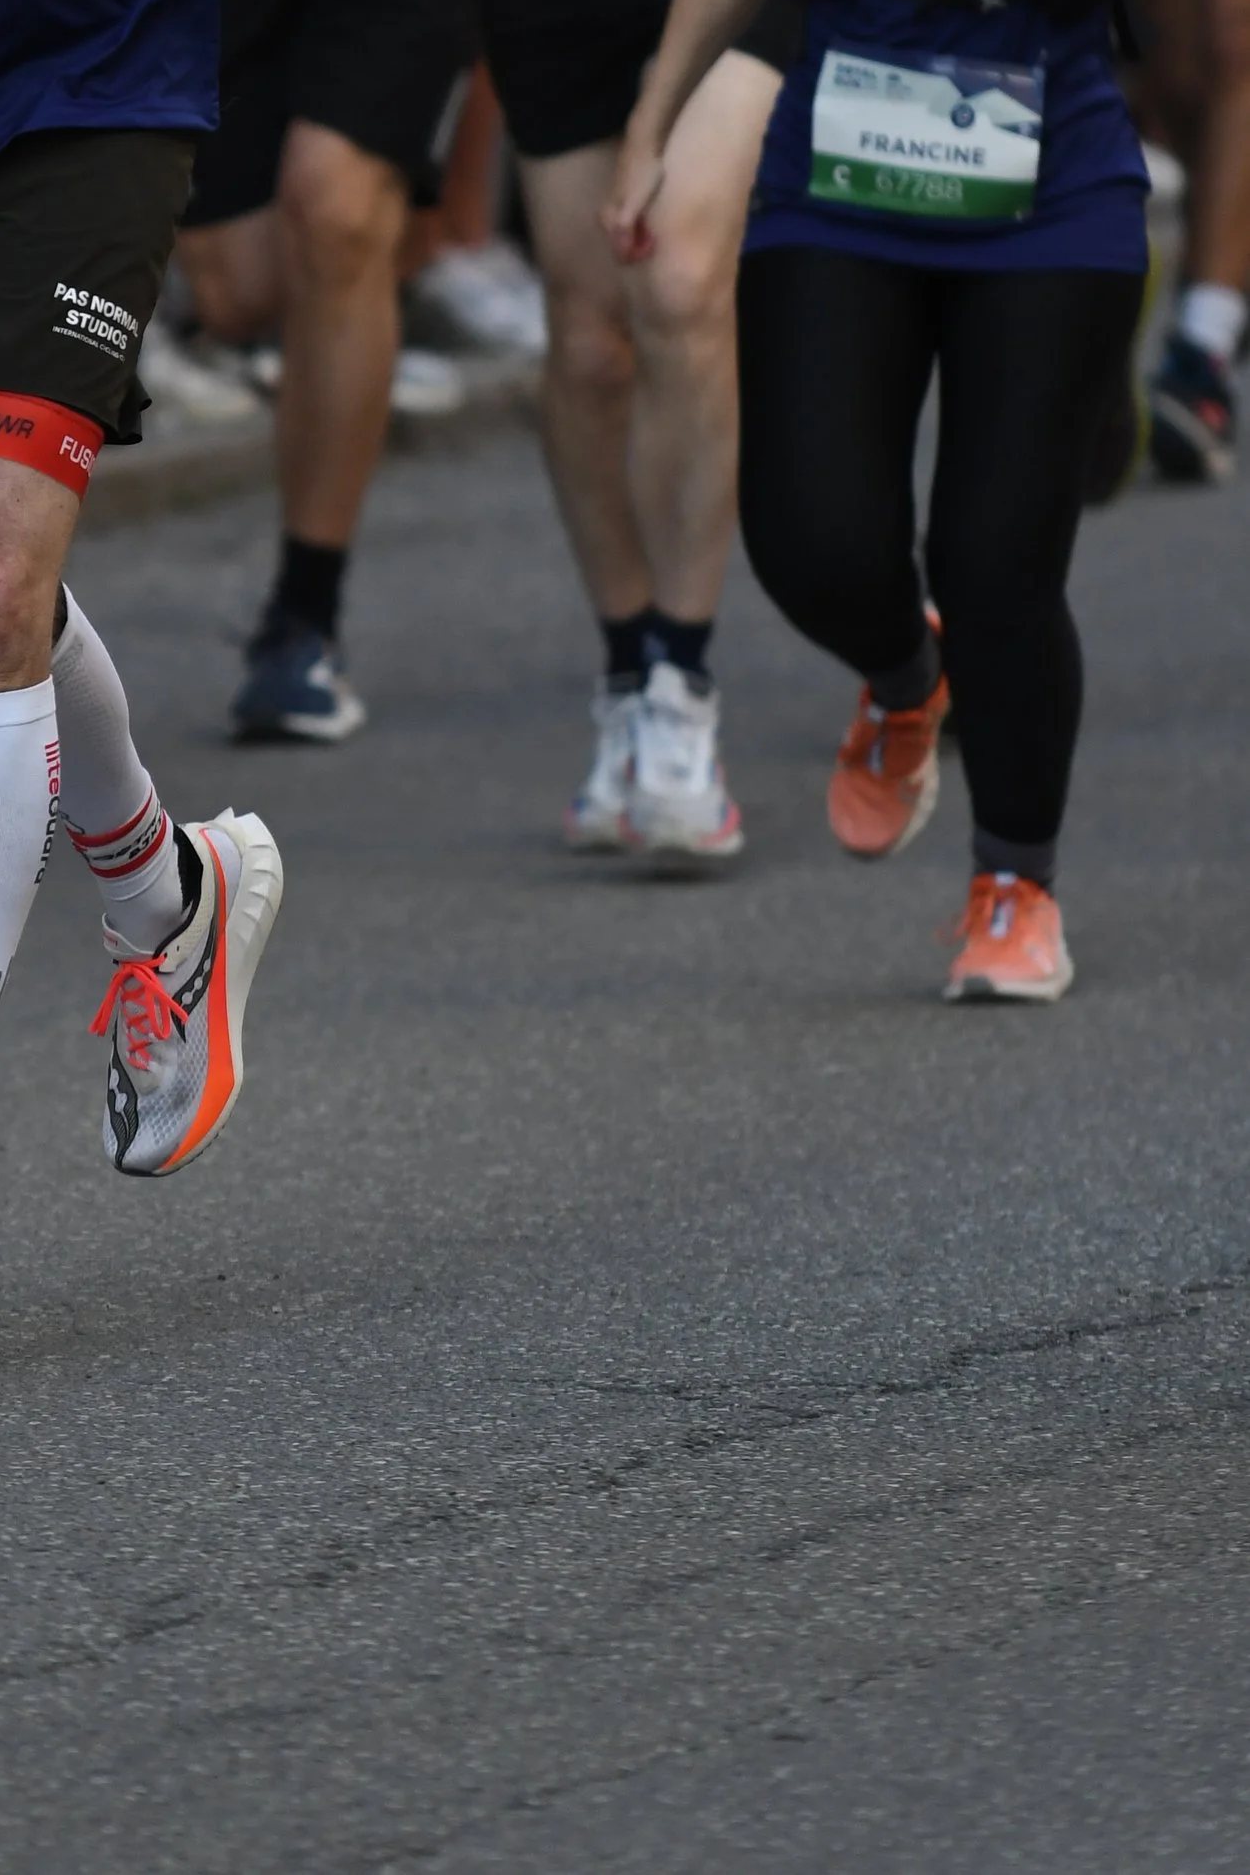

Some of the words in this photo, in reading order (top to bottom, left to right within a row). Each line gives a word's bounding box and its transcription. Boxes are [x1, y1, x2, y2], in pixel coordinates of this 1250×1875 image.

[859, 130, 987, 167] FRANCINE
[833, 164, 852, 189] C
[53, 282, 90, 307] PAS
[90, 295, 139, 338] NORMAL
[52, 325, 99, 348] INTERNATIONAL
[65, 309, 128, 350] STUDIOS
